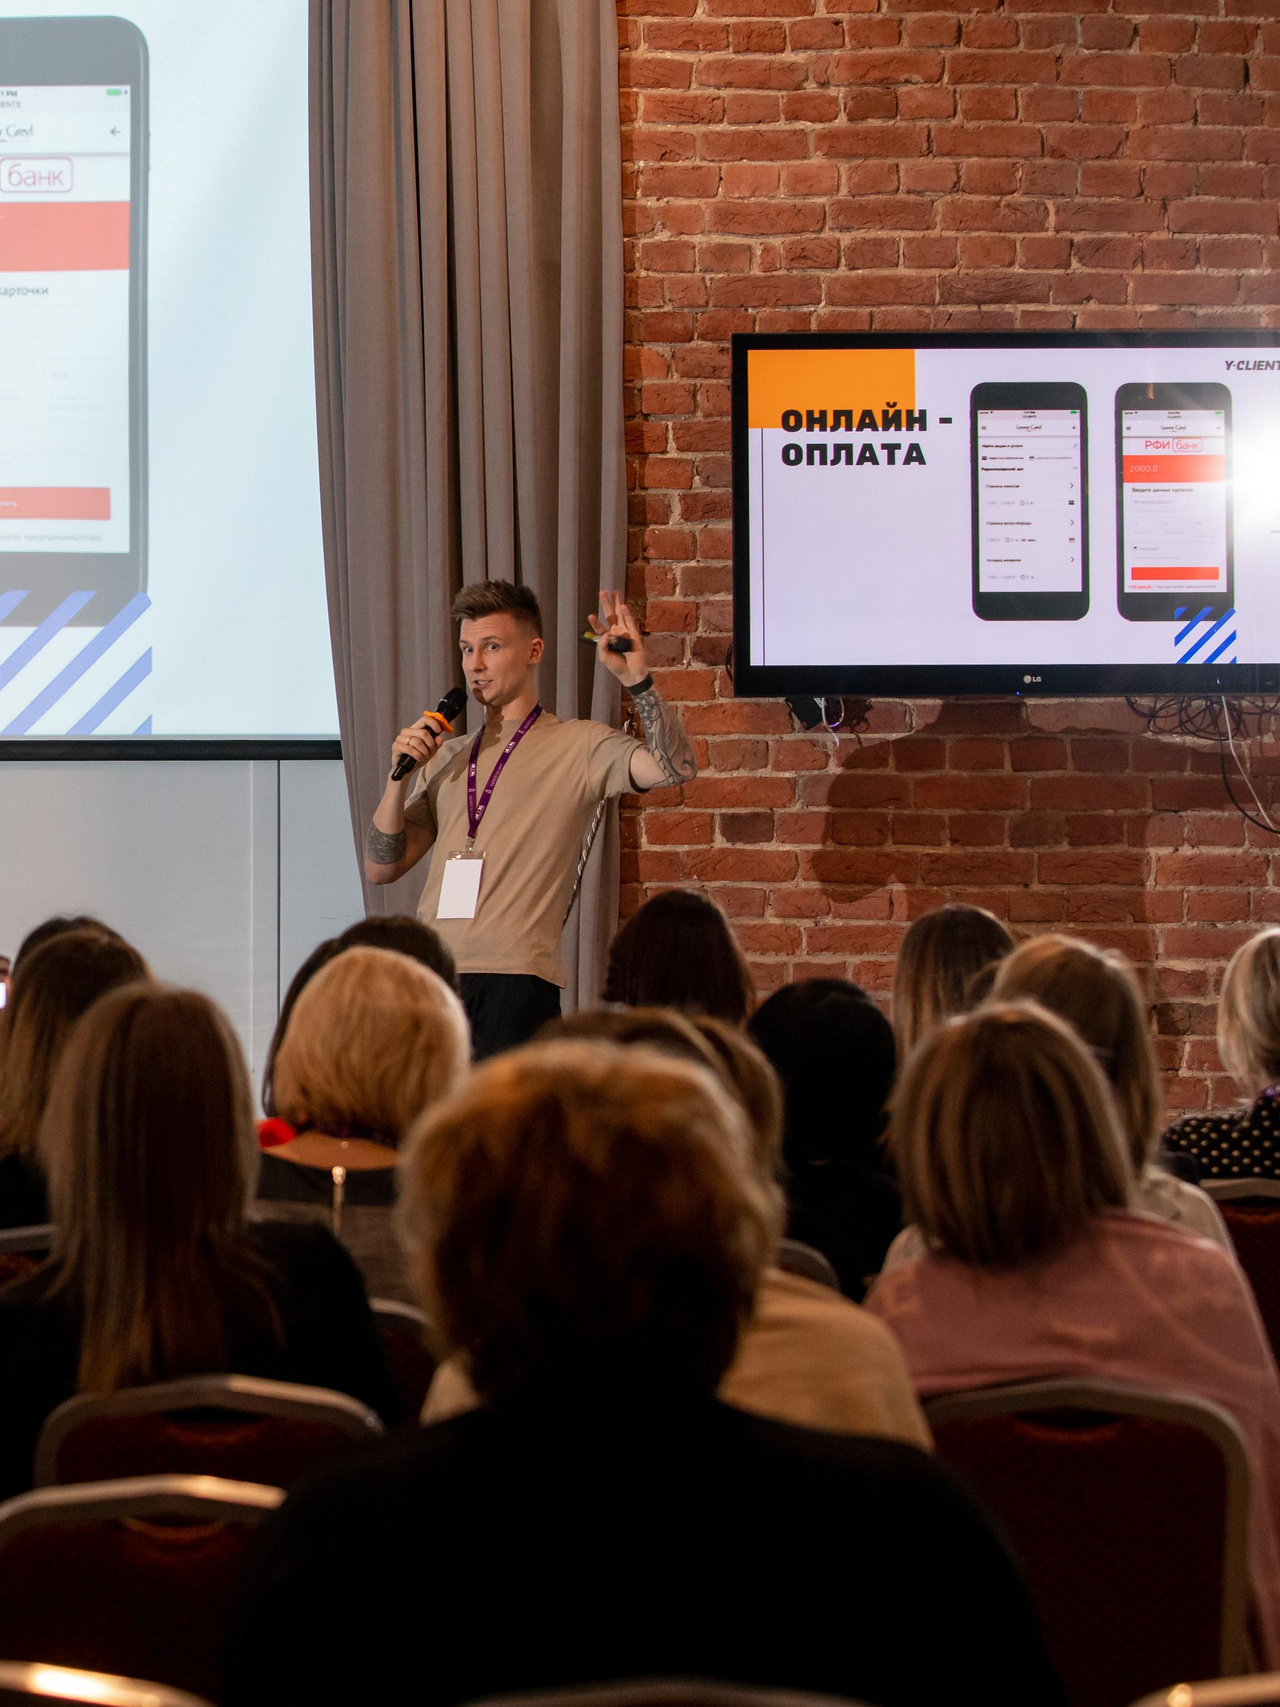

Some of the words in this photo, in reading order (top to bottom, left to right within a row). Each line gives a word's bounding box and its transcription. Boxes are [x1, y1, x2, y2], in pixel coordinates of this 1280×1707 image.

[7, 163, 65, 187] банк
[781, 402, 927, 432] ОНЛАЙН
[781, 443, 927, 466] ОПЛАТА
[1145, 441, 1170, 449] РФИ
[1176, 440, 1199, 449] банк
